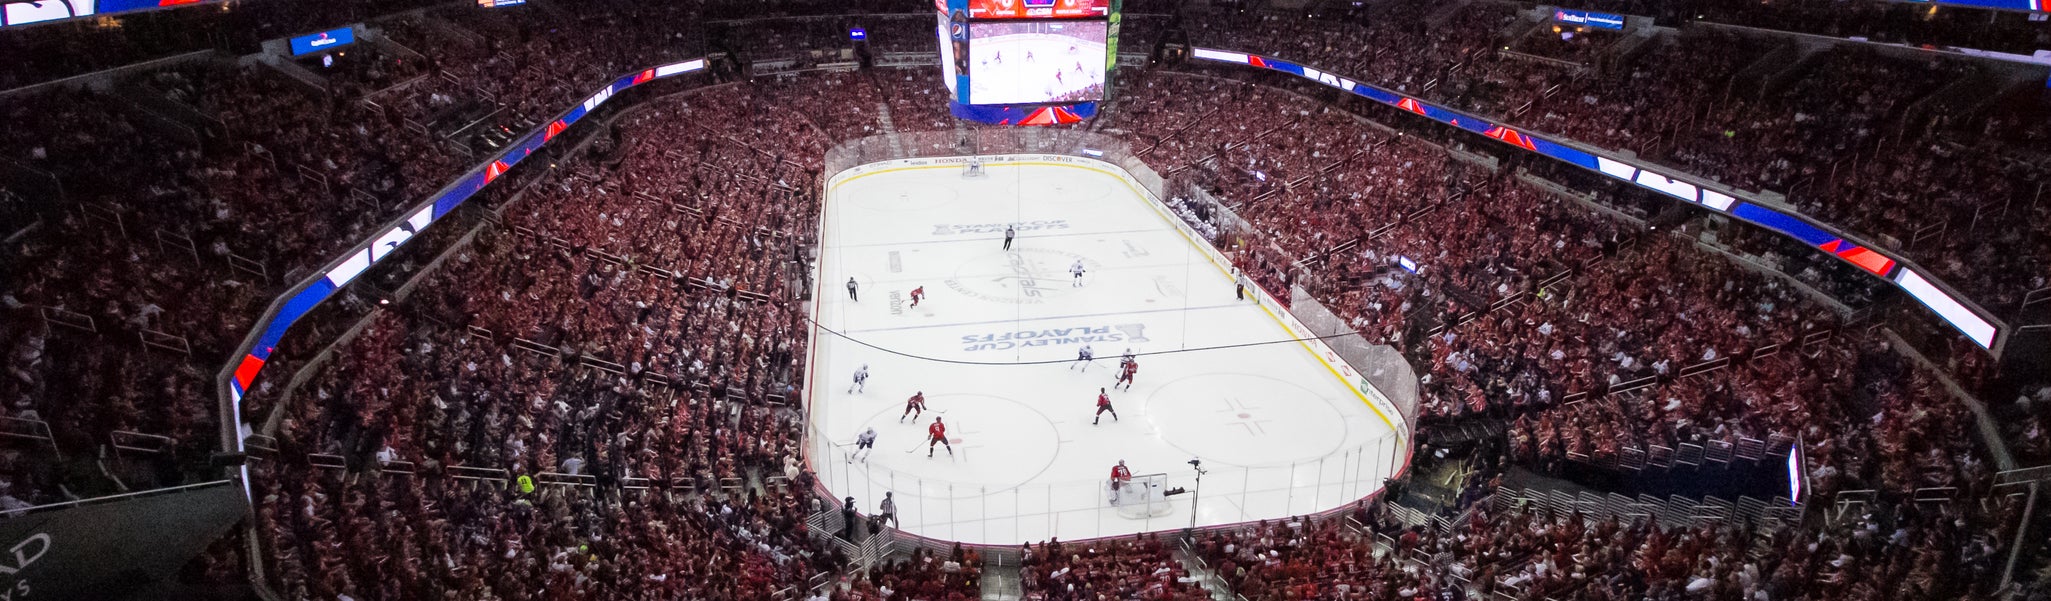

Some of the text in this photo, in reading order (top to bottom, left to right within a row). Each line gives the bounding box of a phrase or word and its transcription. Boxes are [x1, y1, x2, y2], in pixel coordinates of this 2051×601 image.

[1042, 155, 1073, 163] DISCOVER
[960, 223, 1069, 234] PLAOFFS
[961, 325, 1110, 344] PLAYOFFS
[963, 333, 1124, 352] STANLEY CUP
